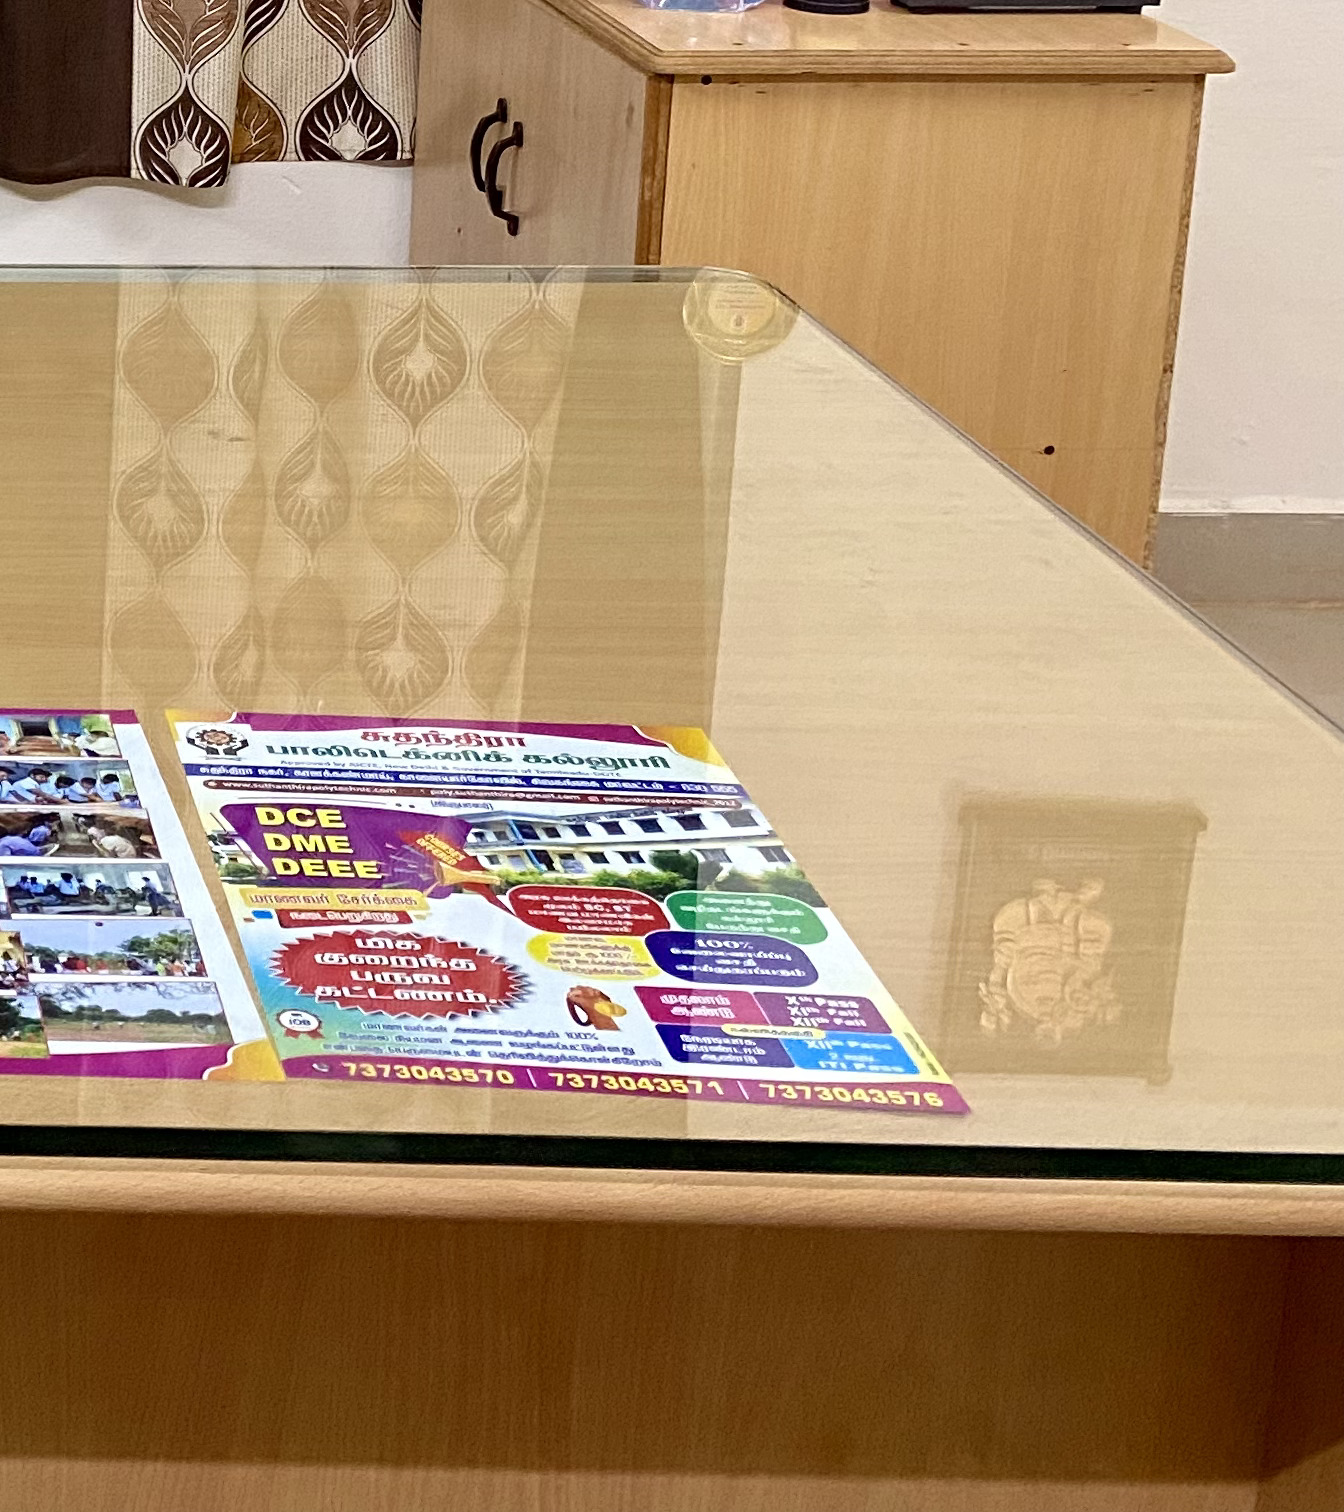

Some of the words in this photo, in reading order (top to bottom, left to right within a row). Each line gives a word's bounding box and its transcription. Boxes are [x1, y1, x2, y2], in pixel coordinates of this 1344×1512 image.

[360, 729, 527, 748] சுதந்திரா
[264, 743, 513, 763] பாலிடெக்னிக்
[521, 752, 671, 771] கல்லூரி
[254, 805, 347, 830] DCE
[262, 831, 355, 855] DME
[271, 857, 386, 880] DEEE
[337, 892, 418, 907] சேர்க்கை
[354, 936, 422, 951] மிக
[695, 938, 754, 950] 100%
[313, 951, 478, 972] குறைந்த
[349, 969, 451, 986] பருவ
[314, 985, 500, 1004] கட்டணம்.
[341, 1061, 516, 1086] 7373043570
[547, 1072, 725, 1096] 7373043571
[758, 1082, 945, 1108] 7373043576
